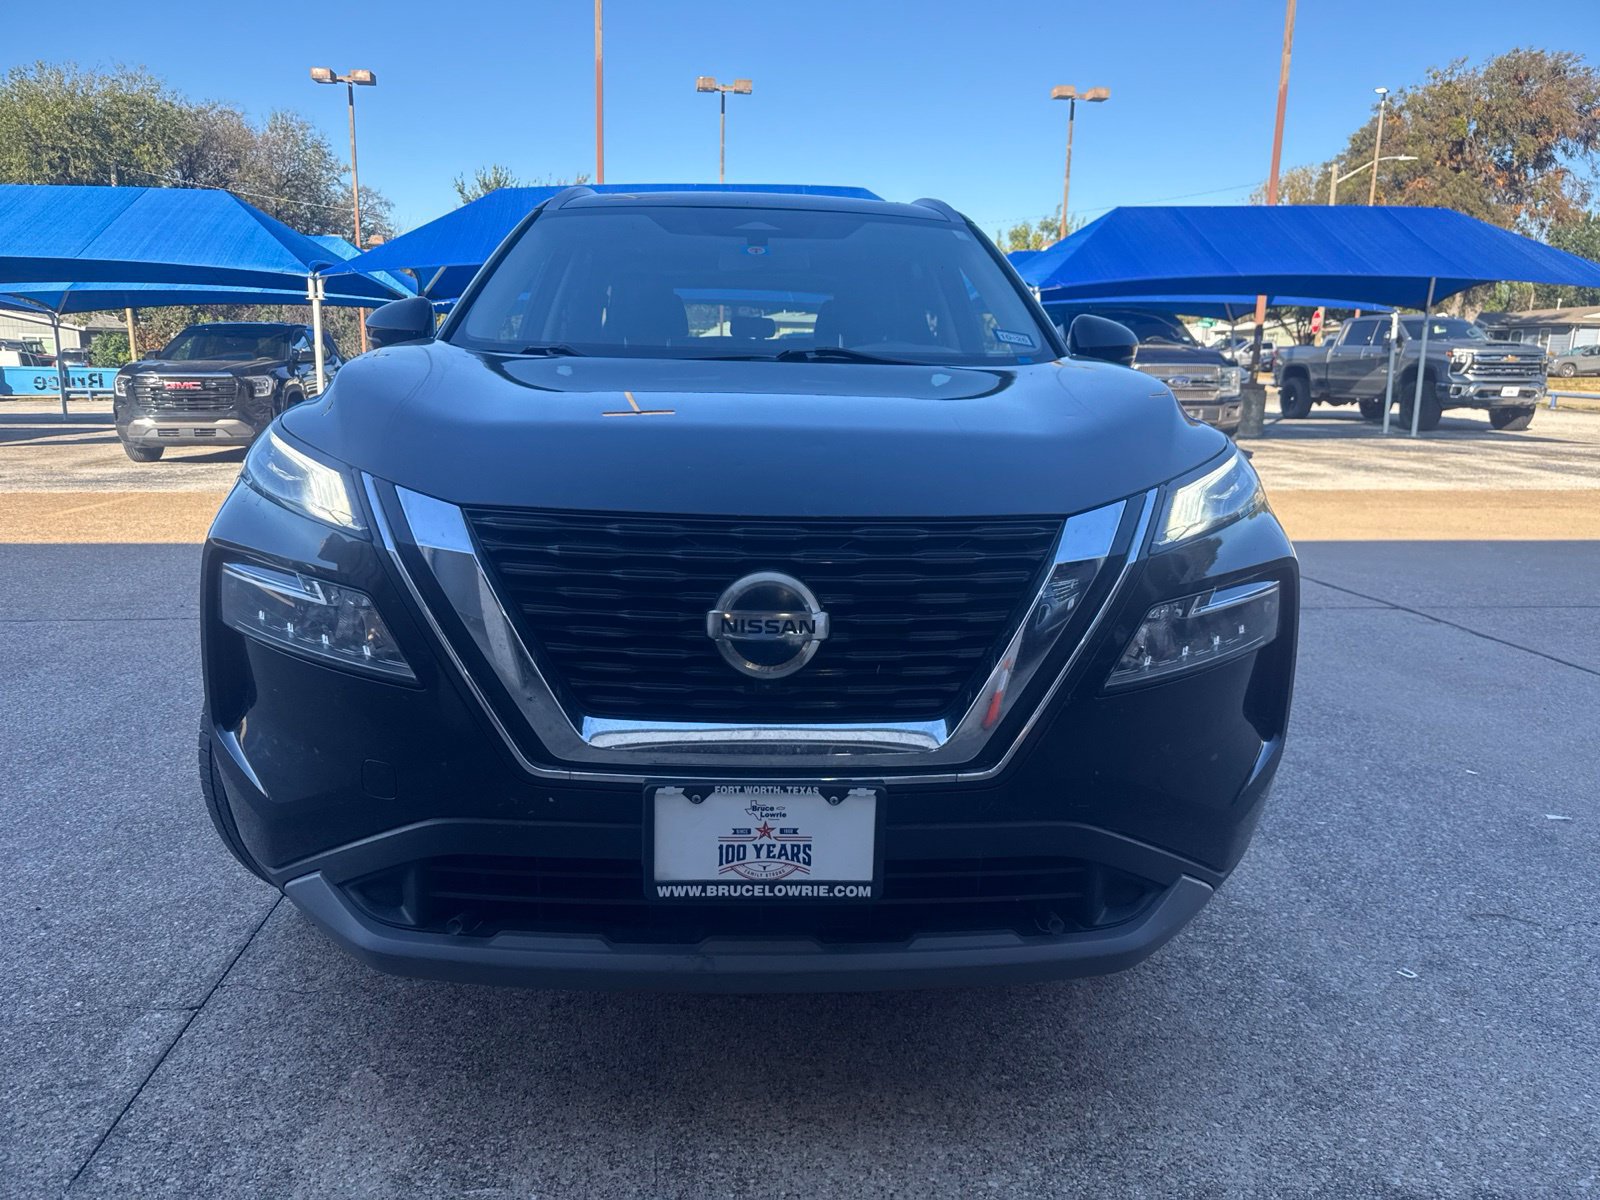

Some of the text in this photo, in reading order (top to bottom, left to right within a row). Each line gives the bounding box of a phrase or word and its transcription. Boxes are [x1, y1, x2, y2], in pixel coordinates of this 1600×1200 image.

[164, 381, 202, 390] GMC
[721, 619, 816, 635] NISSAN
[714, 785, 742, 795] FORT
[786, 786, 820, 796] TEXAS
[718, 843, 812, 867] 100 YEARS
[657, 885, 872, 898] WWW.BRUCELOWRIE.COM
